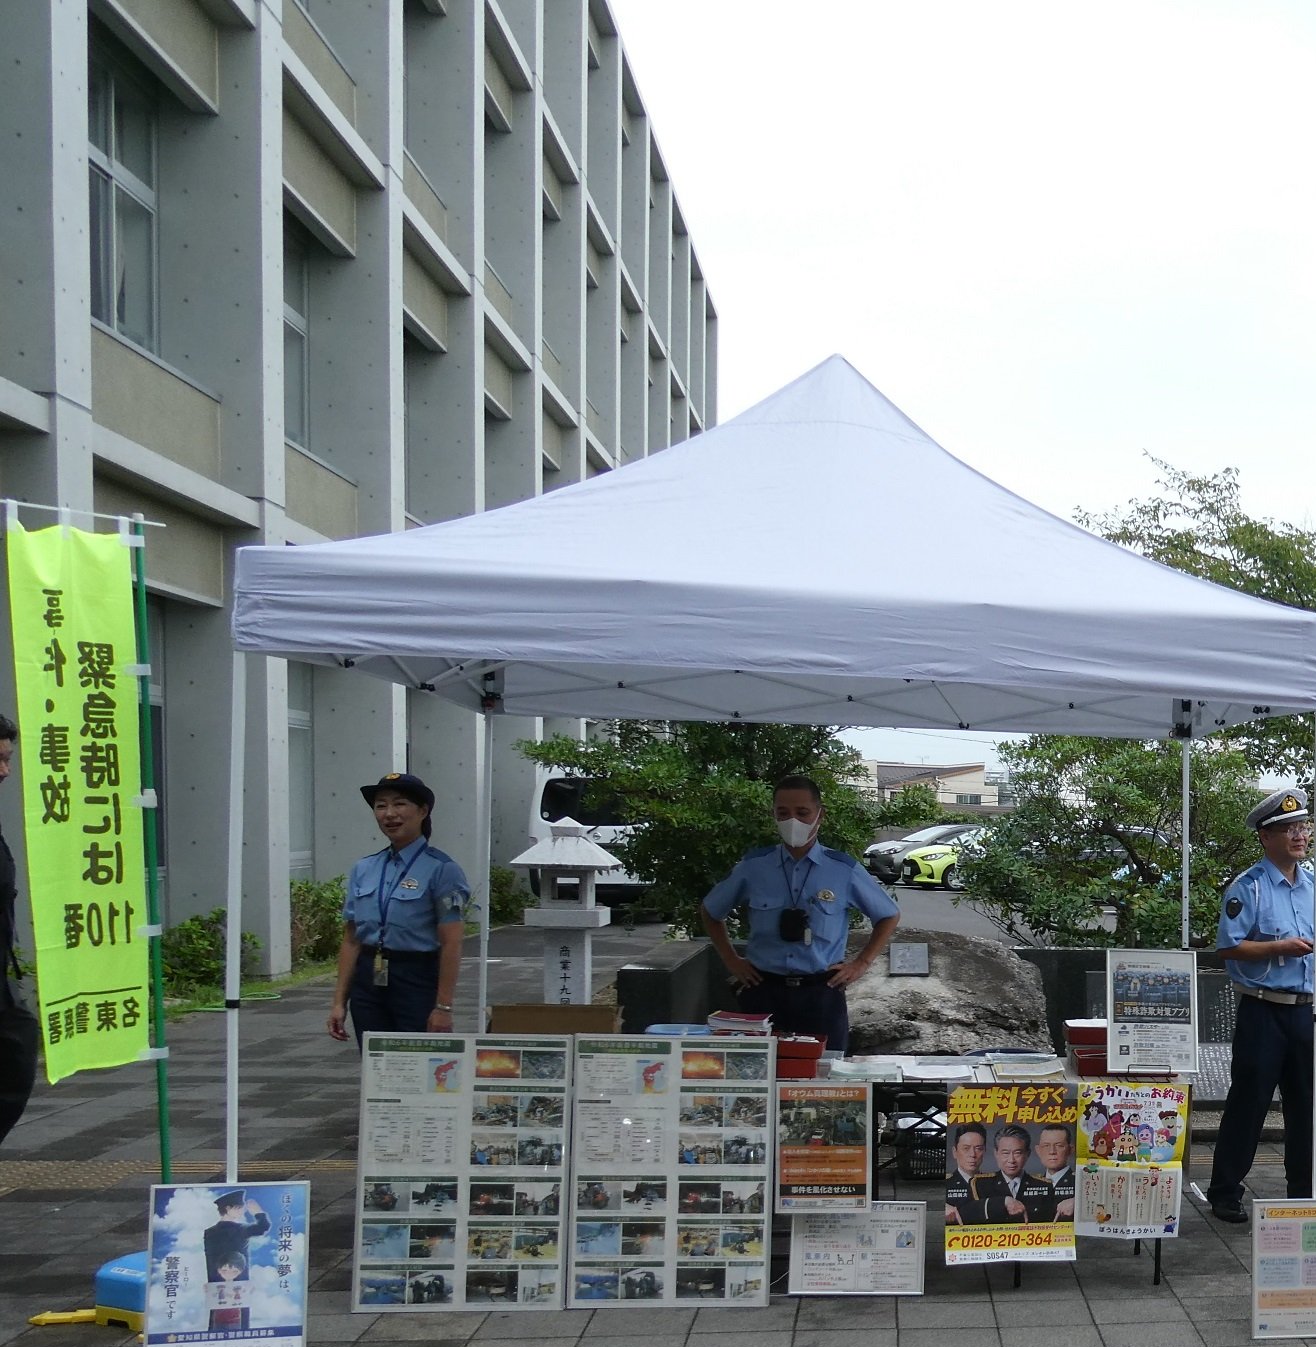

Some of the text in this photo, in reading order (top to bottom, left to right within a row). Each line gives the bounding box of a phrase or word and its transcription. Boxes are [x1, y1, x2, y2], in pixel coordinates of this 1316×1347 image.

[1021, 1086, 1068, 1104] 今すぐ
[948, 1085, 1019, 1124] 無料
[1017, 1106, 1077, 1123] 申し込め
[791, 1185, 856, 1195] 事件を風化させない
[1098, 1227, 1156, 1235] ぼうはんきょうかい
[961, 1232, 1052, 1248] 0120-210-364
[164, 1256, 180, 1320] 警察官です
